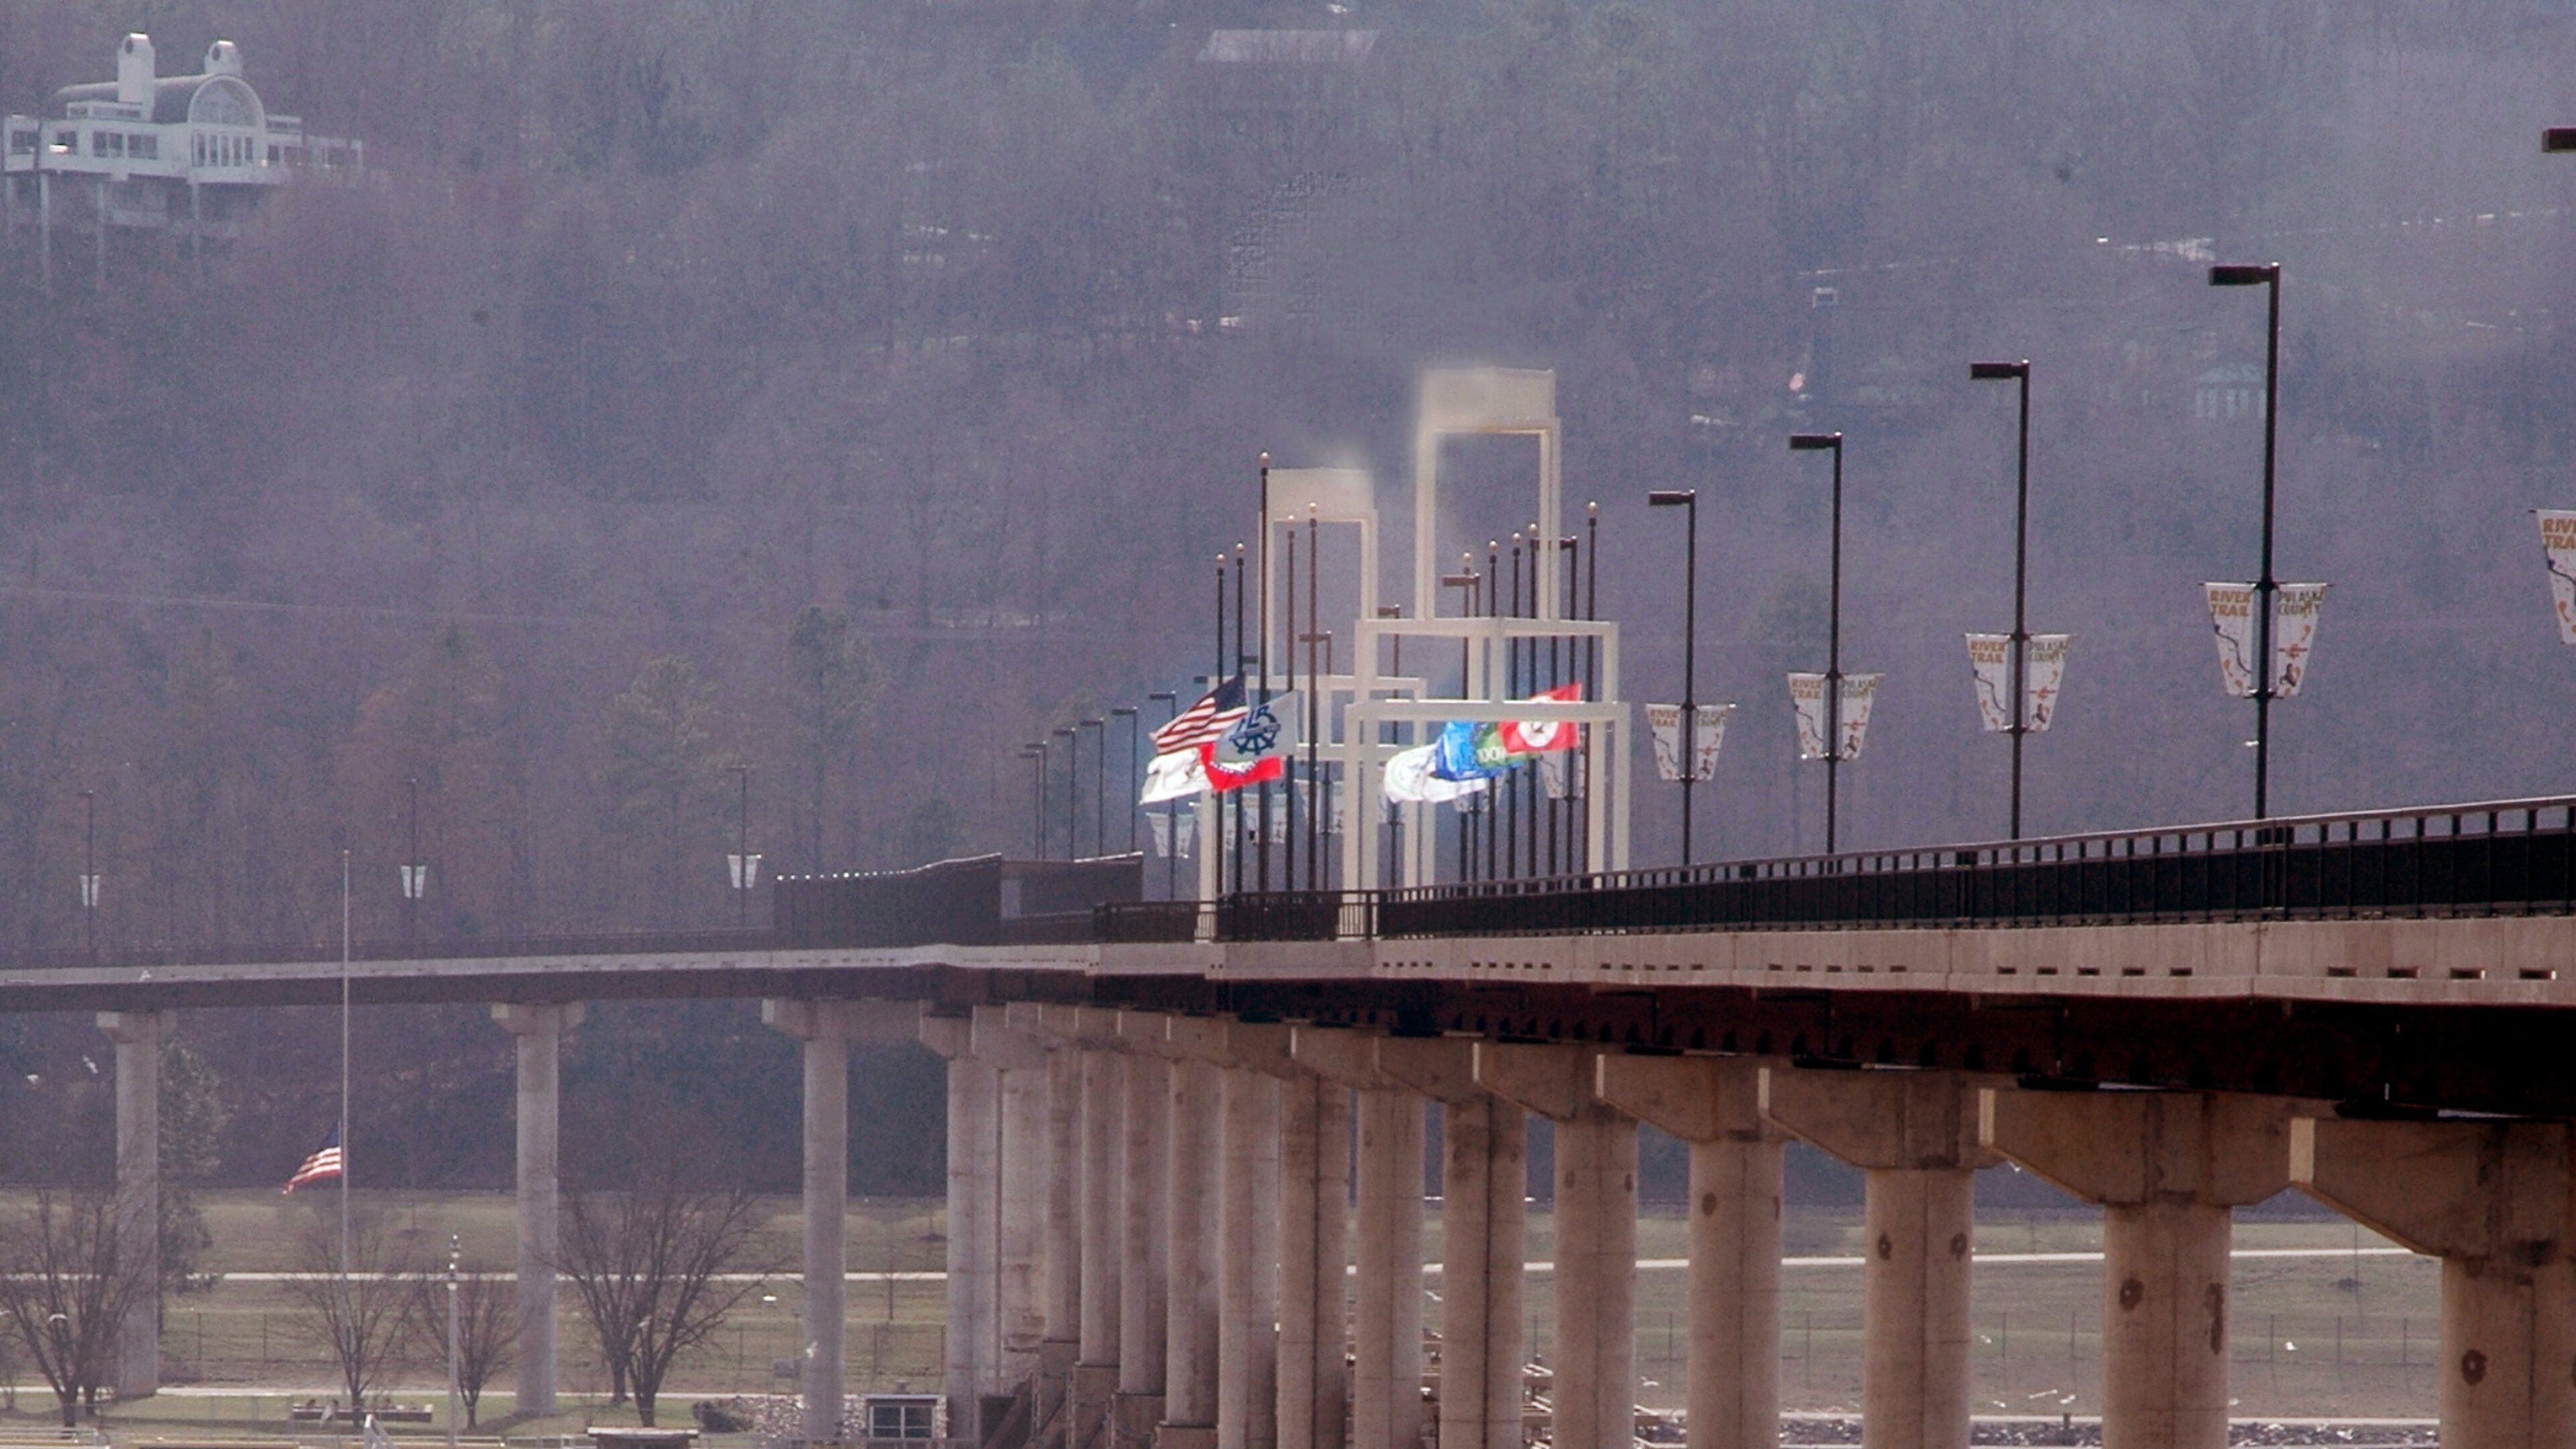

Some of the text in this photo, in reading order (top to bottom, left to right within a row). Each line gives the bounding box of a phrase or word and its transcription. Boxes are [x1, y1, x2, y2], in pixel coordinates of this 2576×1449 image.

[2543, 519, 2576, 533] RIV
[2210, 590, 2251, 602] RIVER
[2210, 604, 2250, 616] TRAIL
[1971, 641, 2004, 651] RIVER
